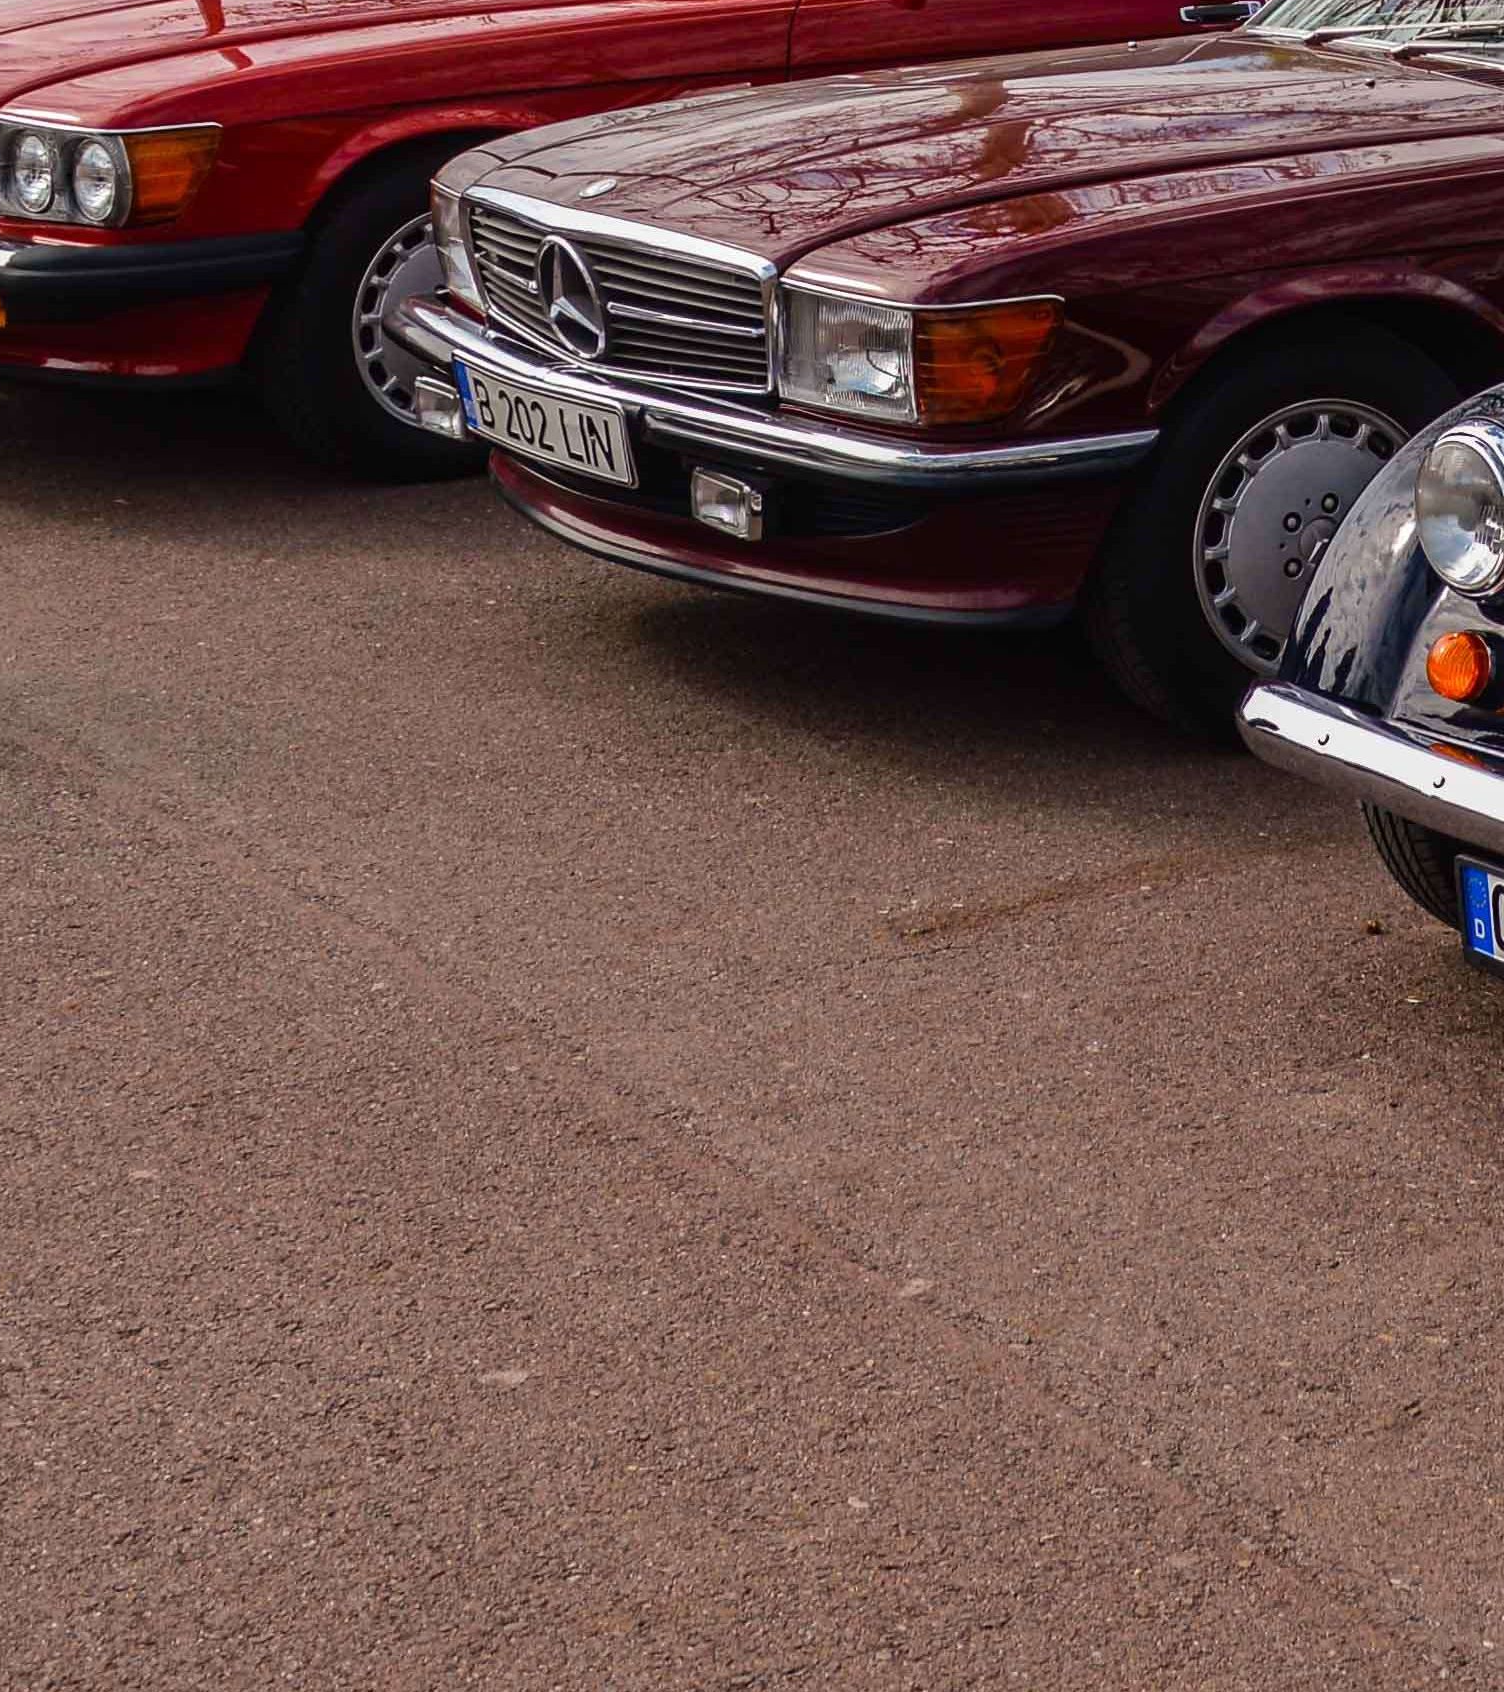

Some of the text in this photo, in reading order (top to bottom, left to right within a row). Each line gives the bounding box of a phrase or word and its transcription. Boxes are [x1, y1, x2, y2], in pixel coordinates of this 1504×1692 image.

[472, 376, 617, 473] B 202 LIN
[1474, 918, 1486, 939] D
